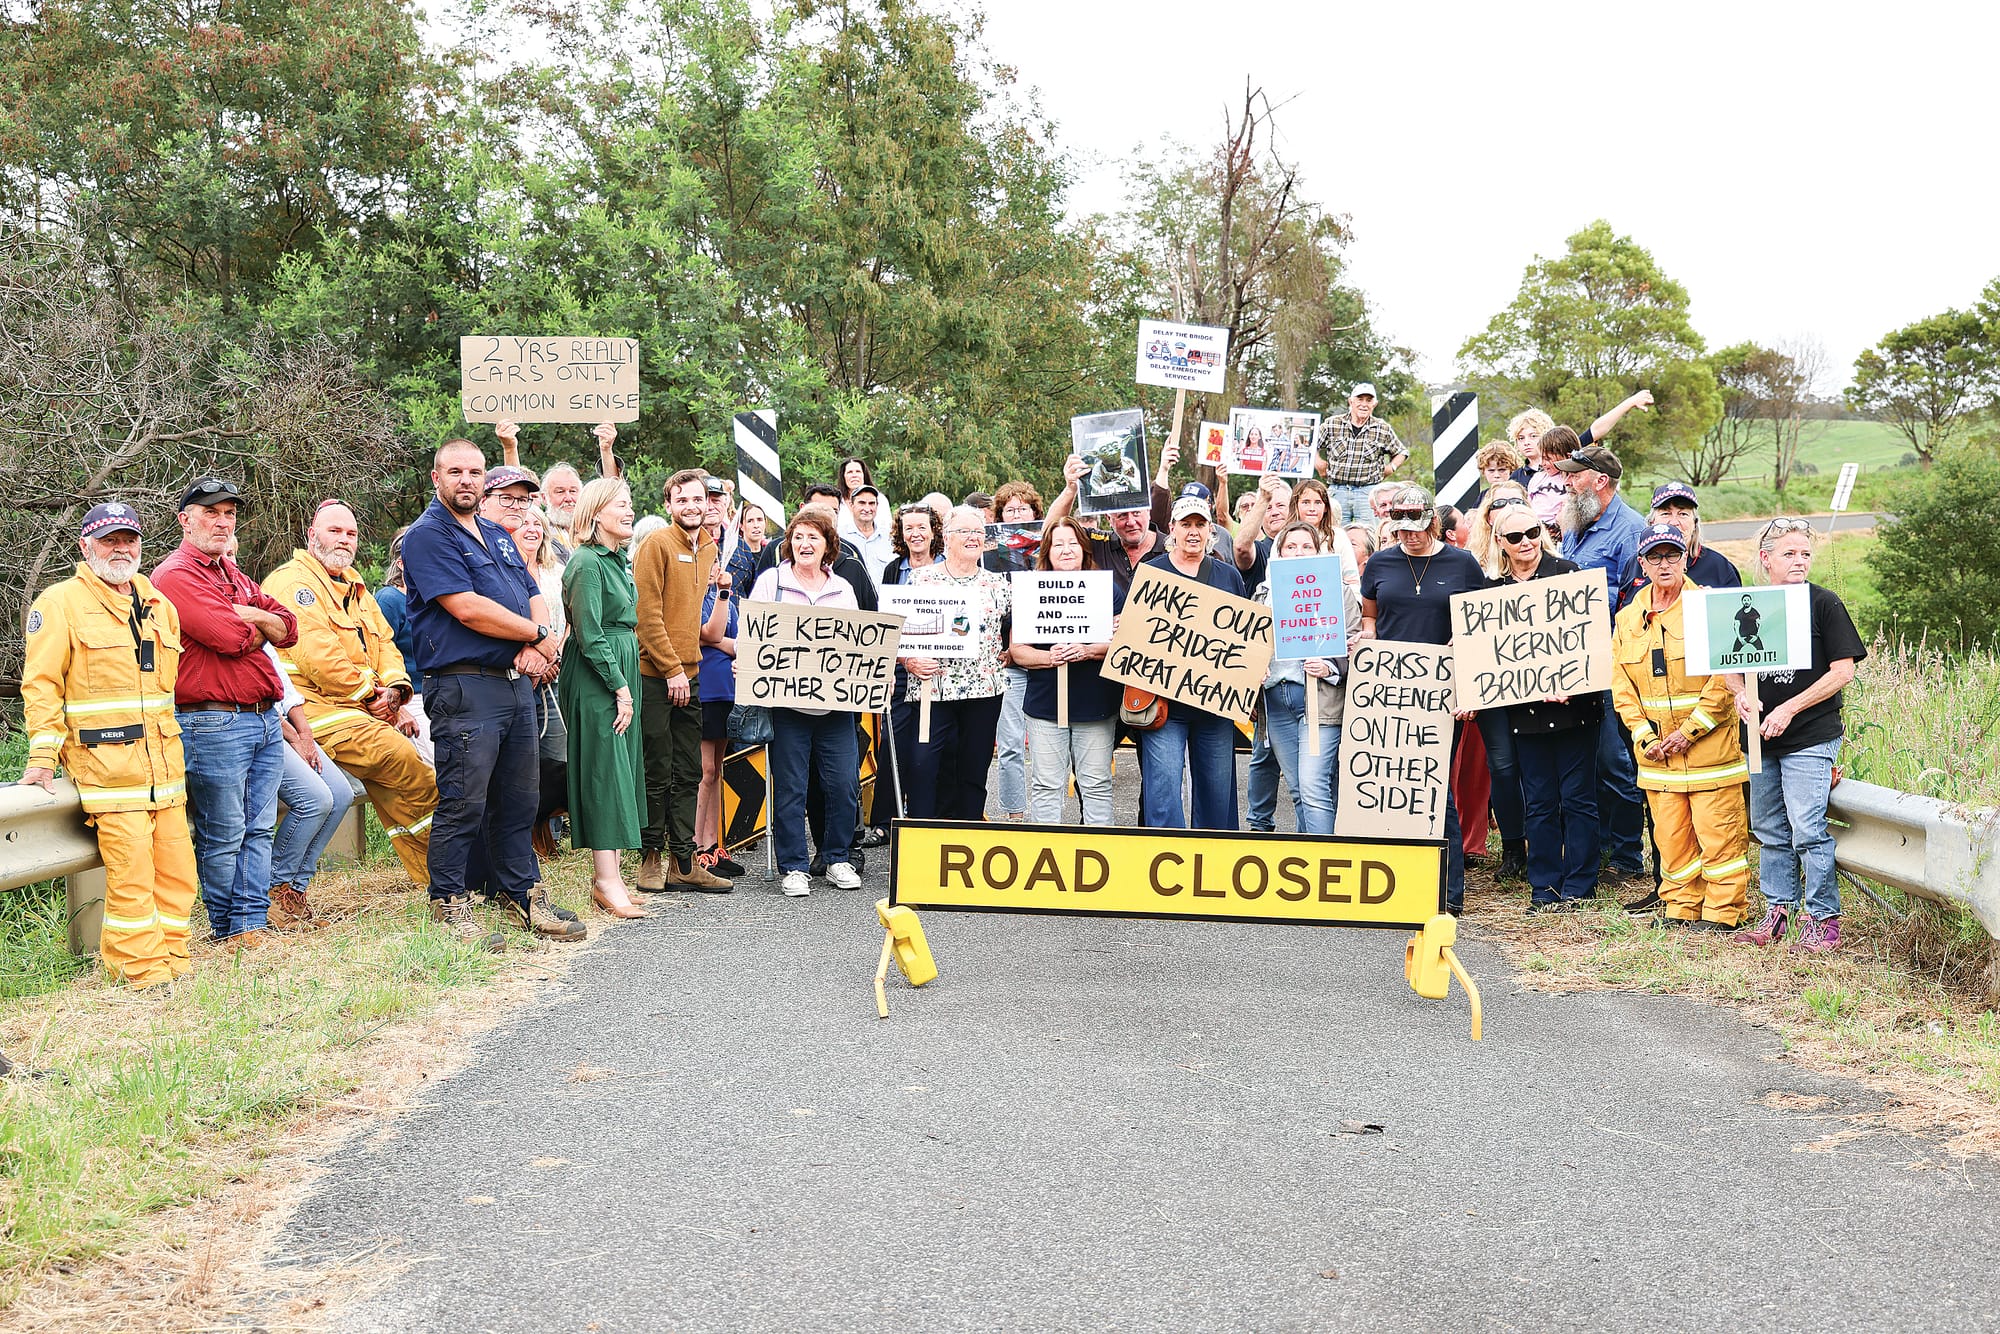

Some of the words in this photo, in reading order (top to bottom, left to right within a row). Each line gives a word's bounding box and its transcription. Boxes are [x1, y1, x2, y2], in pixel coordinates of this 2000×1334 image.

[1153, 329, 1173, 337] DELAY
[1189, 334, 1213, 342] BRIDGE
[484, 338, 503, 362] 2
[514, 338, 559, 363] YRS
[571, 339, 638, 363] REALLY
[468, 365, 544, 384] CARS
[556, 365, 621, 384] ONLY
[1150, 363, 1170, 371] DELAY
[1171, 366, 1211, 376] EMERGENCY
[1164, 373, 1196, 382] SERVICES
[470, 393, 555, 412] COMMON
[569, 393, 638, 409] SENSE
[1038, 580, 1074, 589] BUILD
[1078, 580, 1086, 589] A
[1291, 588, 1322, 599] AND
[1295, 574, 1317, 585] GO
[1039, 595, 1085, 604] BRIDGE
[1133, 580, 1199, 620] MAKE
[1213, 605, 1273, 643] OUR
[1294, 603, 1322, 613] GET
[1461, 594, 1536, 635] BRING
[1545, 585, 1602, 622] BACK
[747, 610, 780, 642] WE
[796, 616, 899, 647] KERNOT
[1037, 611, 1062, 619] AND
[1280, 616, 1339, 629] FUNDED
[1035, 626, 1075, 634] THATS
[1078, 626, 1090, 634] IT
[1146, 617, 1248, 670] BRIDGE
[1494, 621, 1592, 665] KERNOT
[757, 644, 811, 670] GET
[816, 647, 842, 673] TO
[845, 652, 890, 679] THE
[1353, 646, 1430, 680] GRASS
[1435, 655, 1453, 681] IS
[1720, 653, 1744, 666] JUST
[1747, 653, 1761, 664] DO
[1763, 651, 1777, 662] IT!
[752, 676, 825, 702] OTHER
[833, 678, 891, 712] SIDE!
[1110, 645, 1177, 689] GREAT
[1174, 668, 1256, 716] AGAIN!
[1473, 654, 1589, 705] BRIDGE!
[1352, 681, 1453, 714] GREENER
[1350, 716, 1387, 749] ON
[1391, 716, 1440, 748] THE
[1350, 751, 1443, 788] OTHER
[1356, 781, 1437, 823] SIDE!
[939, 844, 1110, 893] ROAD
[1148, 852, 1397, 905] CLOSED
